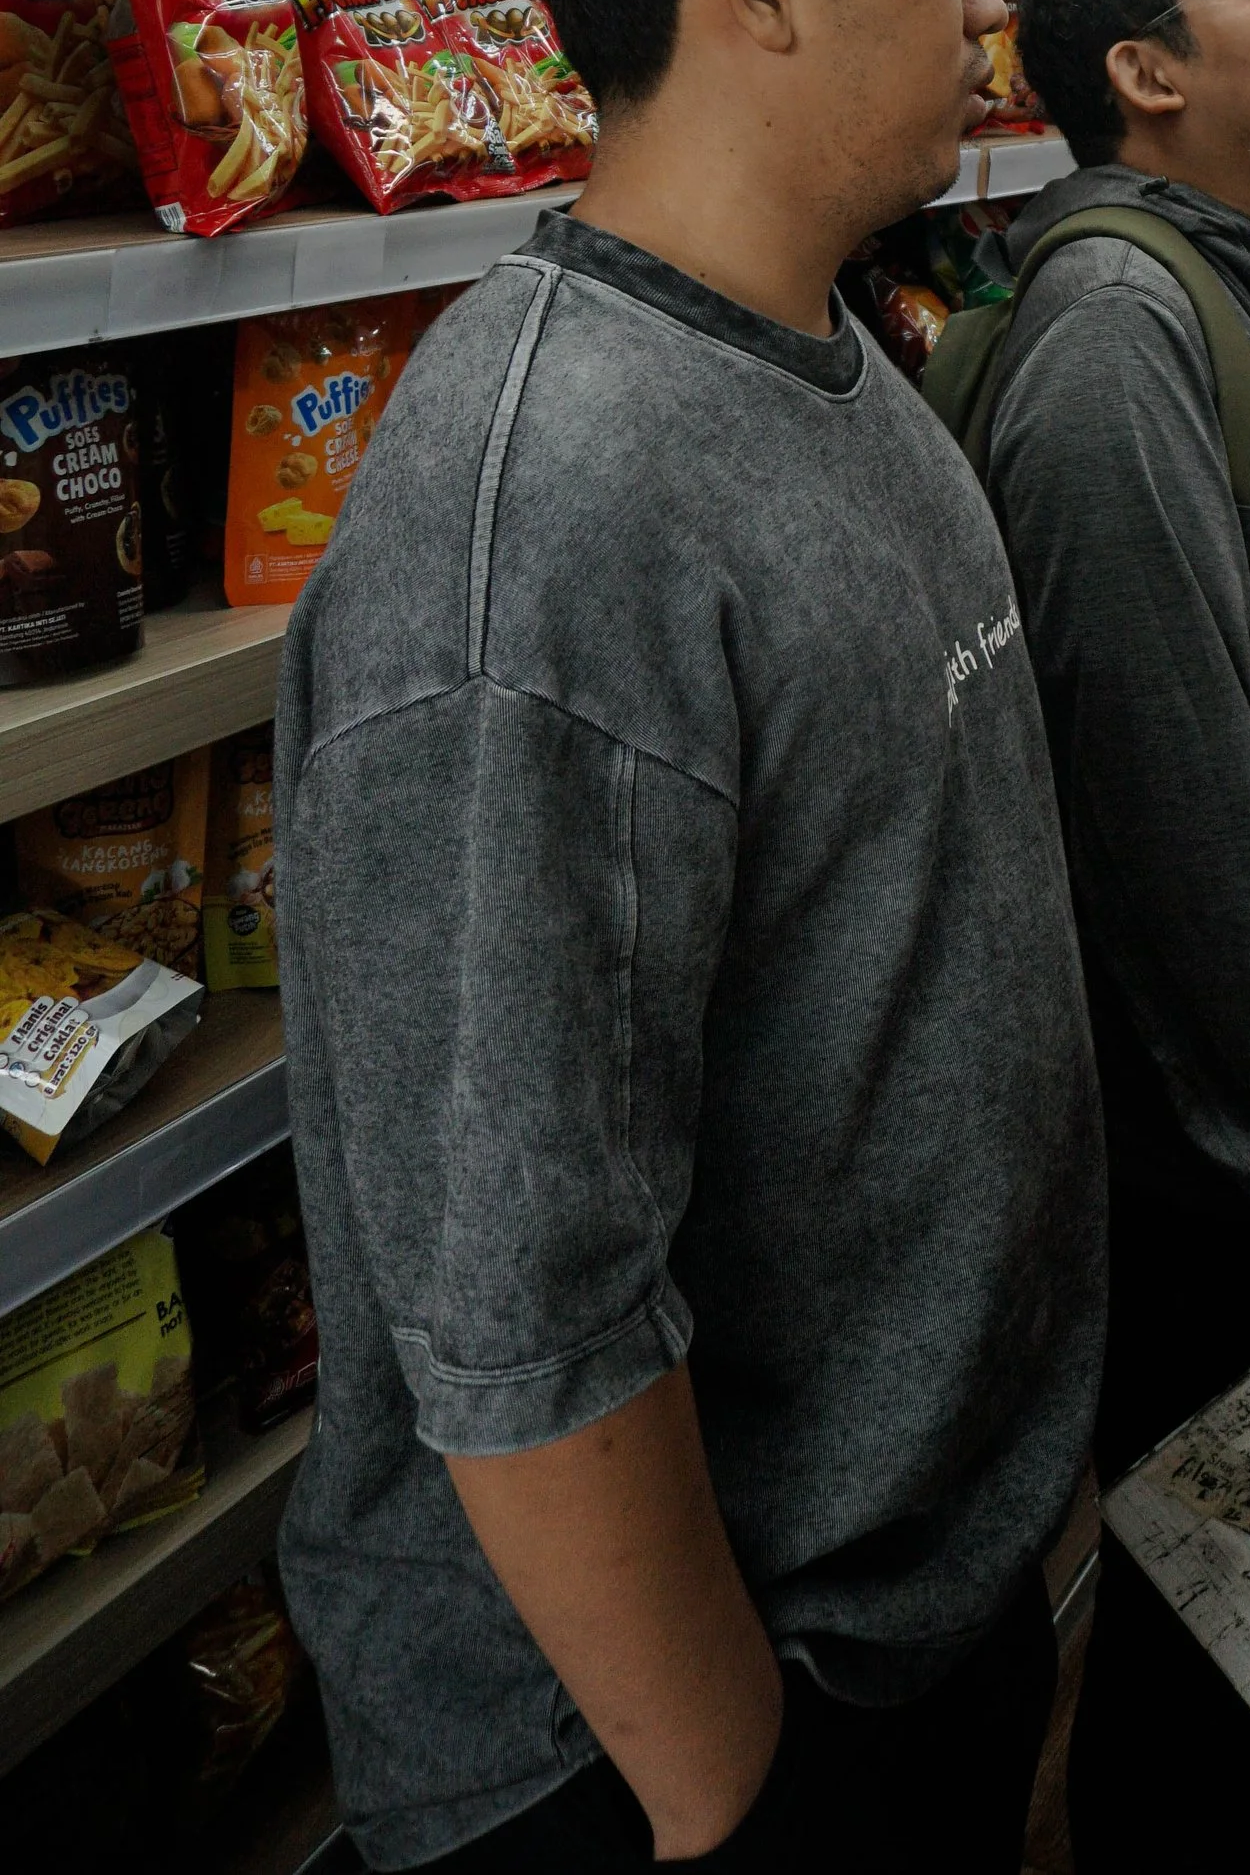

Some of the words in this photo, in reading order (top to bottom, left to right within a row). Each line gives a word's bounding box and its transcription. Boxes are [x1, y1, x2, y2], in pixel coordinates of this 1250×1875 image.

[4, 372, 127, 448] Puffies
[64, 425, 101, 450] SOES
[52, 442, 120, 476] CREAM
[55, 466, 123, 502] CHOCO
[81, 839, 153, 860] KACANG
[11, 1002, 49, 1045] Manis
[27, 1002, 73, 1053] Original
[43, 1018, 81, 1062] Coklat
[69, 1035, 88, 1058] 120
